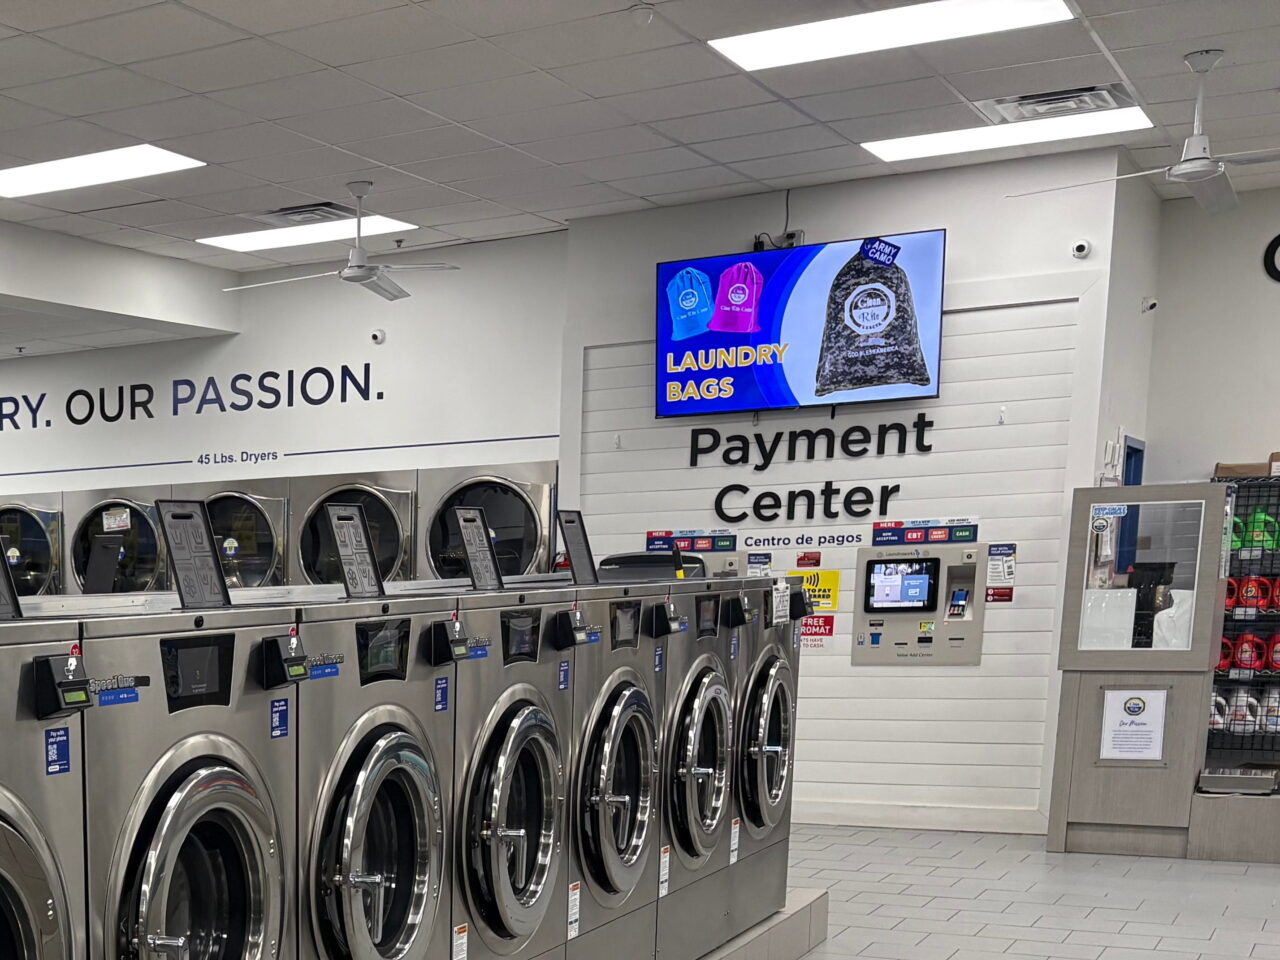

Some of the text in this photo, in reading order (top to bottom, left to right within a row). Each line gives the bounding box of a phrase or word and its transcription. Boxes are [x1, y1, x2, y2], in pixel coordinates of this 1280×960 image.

[869, 249, 893, 264] CAMO
[872, 240, 897, 255] ARMY
[666, 343, 790, 373] LAUNDRY
[65, 383, 155, 425] OUR
[172, 363, 384, 416] PASSION.
[666, 377, 734, 402] BAGS
[690, 412, 934, 471] Payment
[197, 450, 278, 465] 45 Lbs. Dryers
[714, 481, 900, 523] Center
[744, 533, 862, 549] Centro de pagos
[800, 626, 830, 634] ROMAT
[90, 675, 118, 694] Speed
